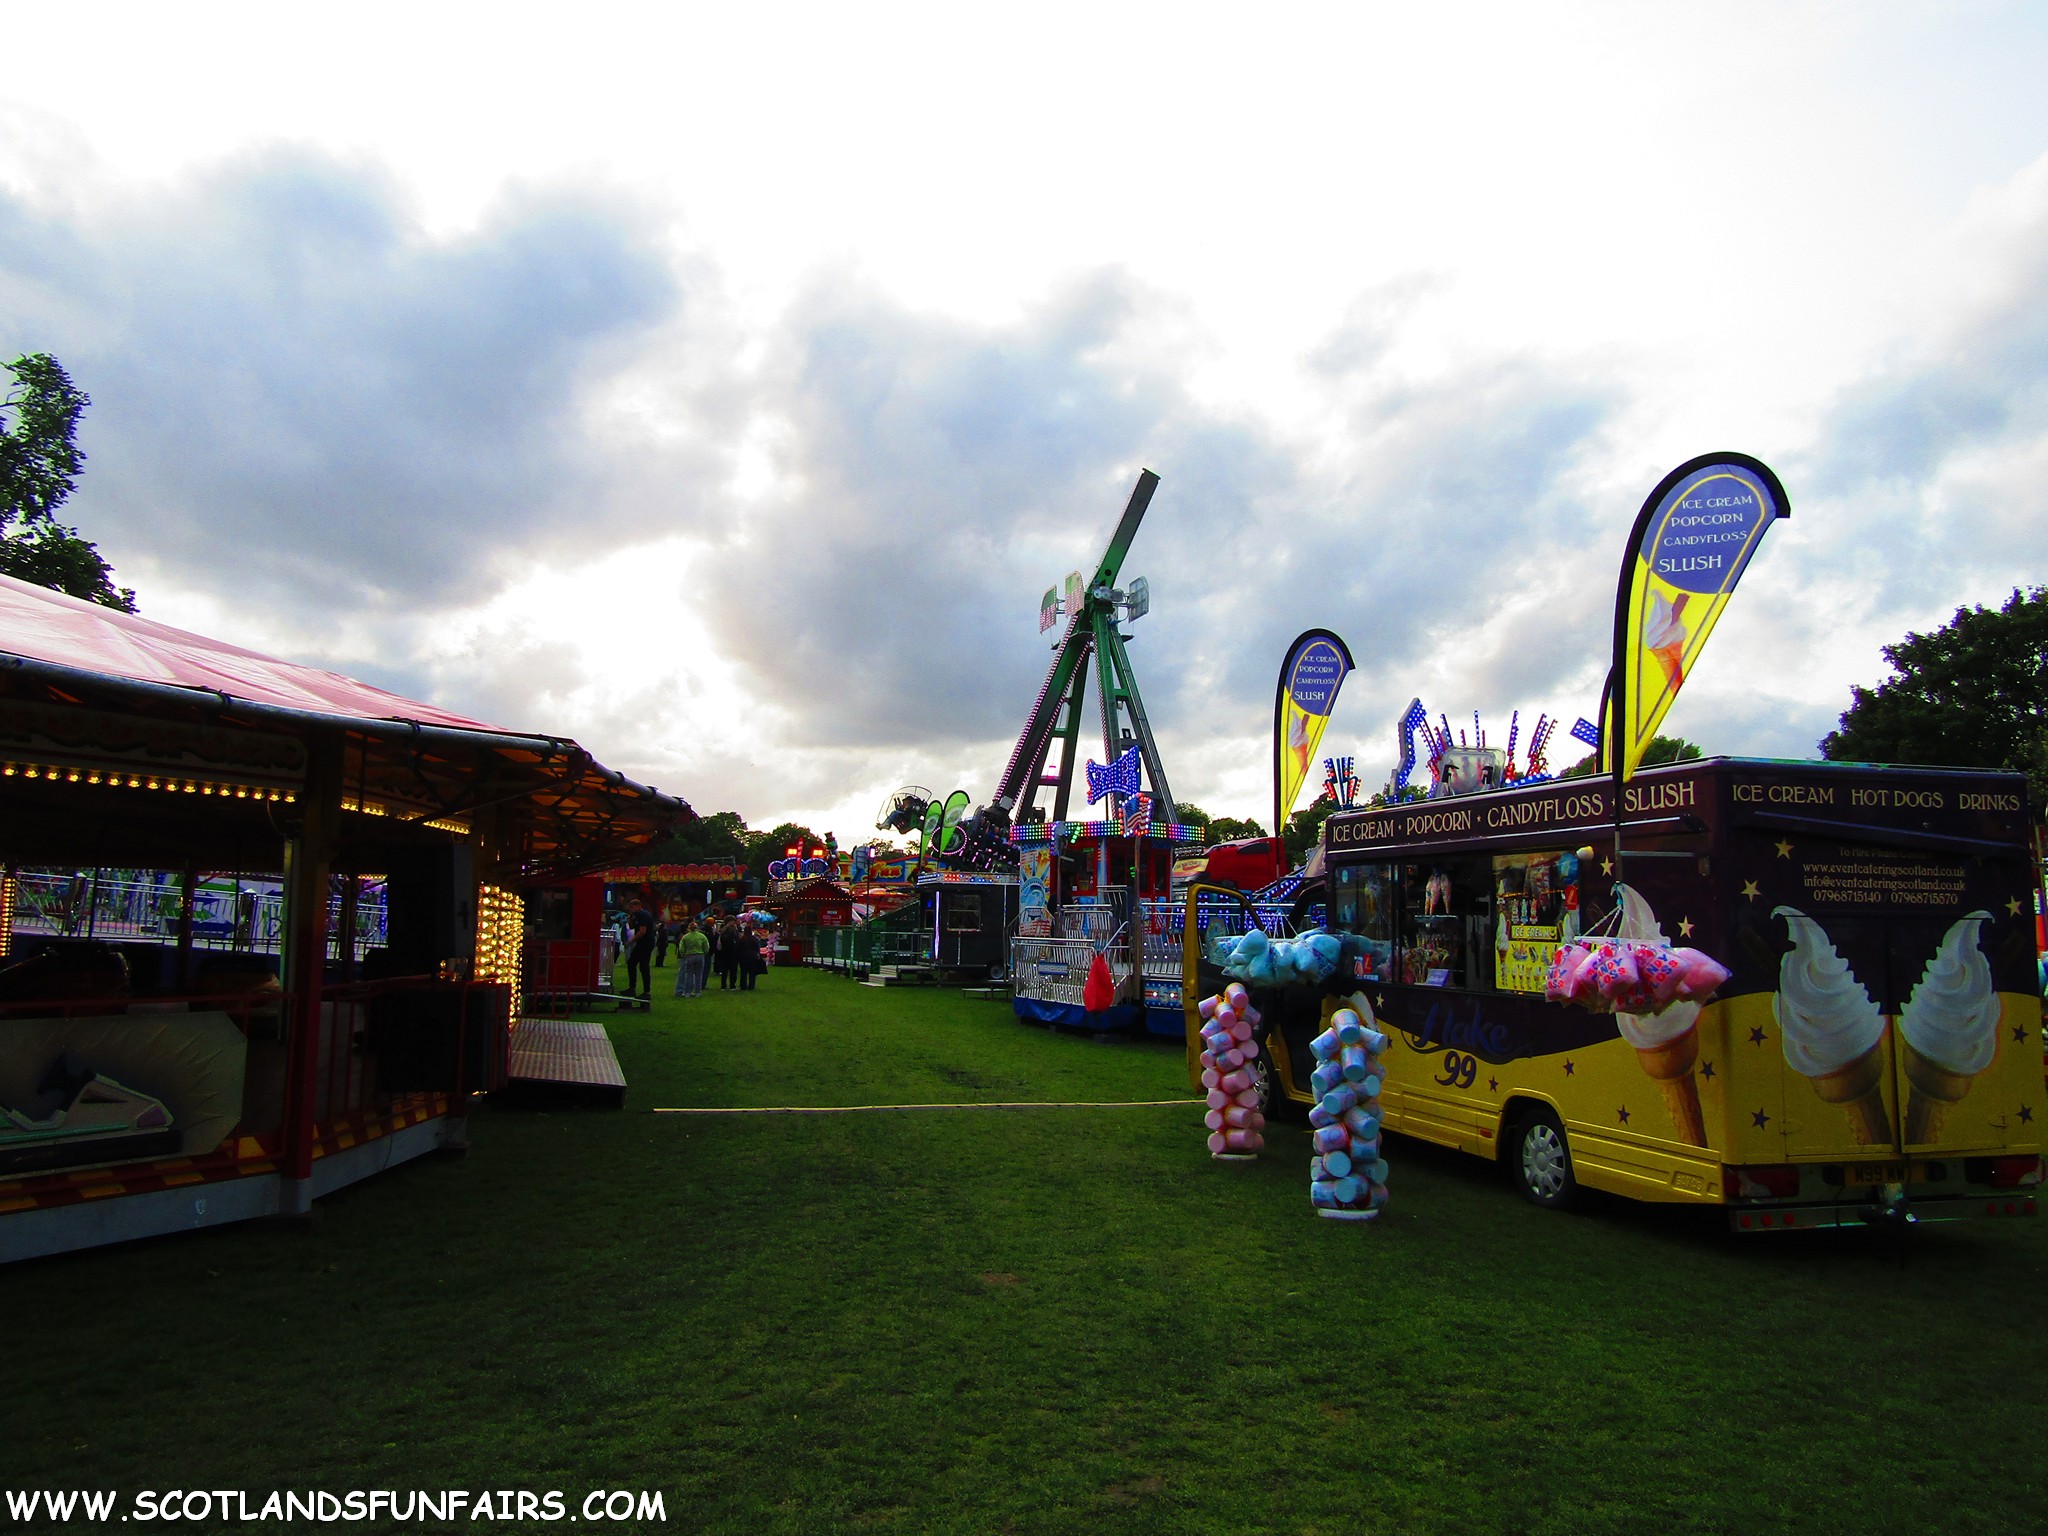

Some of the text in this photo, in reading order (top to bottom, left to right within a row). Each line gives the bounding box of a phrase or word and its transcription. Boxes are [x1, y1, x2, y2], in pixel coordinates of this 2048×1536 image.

[1681, 495, 1752, 510] ICE CREAM
[1670, 513, 1744, 528] POPCORN
[1663, 530, 1748, 547] CANDYFLOSS
[1657, 554, 1722, 573] SLUSH
[1299, 665, 1334, 673] POPCORN
[1296, 677, 1336, 685] CANDYFLOSS
[1294, 691, 1325, 701] SLUSH
[1732, 784, 2020, 811] ICE CREAM HOT DOGS DRINKS
[1332, 780, 1695, 843] ICE CREAM POPCORN CANDYFLOSS SLUSH
[1802, 863, 1966, 877] www.eventcateringscotland.co.uk
[1803, 875, 1966, 891] info@eventcateringscotland.co.uk
[1434, 1050, 1477, 1089] 99
